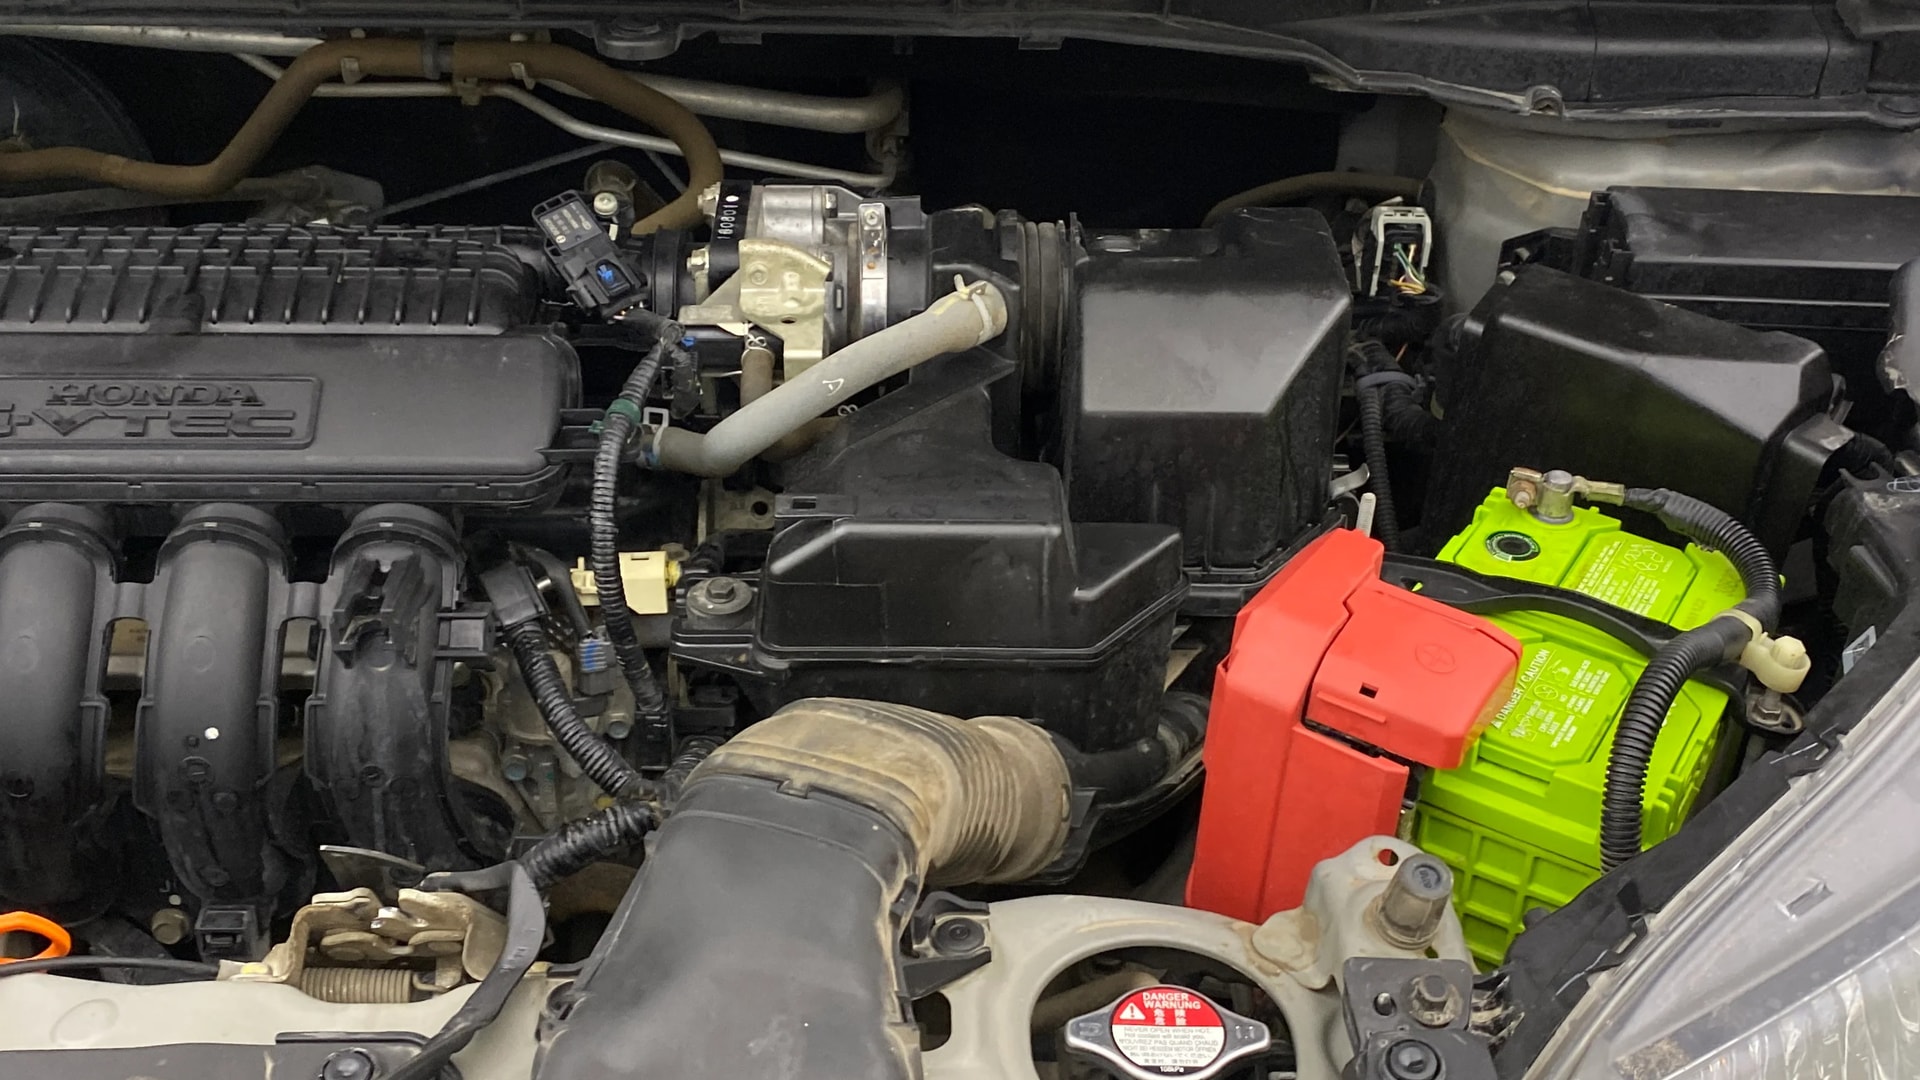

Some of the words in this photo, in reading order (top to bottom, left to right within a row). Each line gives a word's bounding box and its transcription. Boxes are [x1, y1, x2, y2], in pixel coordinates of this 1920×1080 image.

[45, 383, 265, 408] HONDA
[1496, 687, 1526, 721] DANGER
[1520, 648, 1551, 682] CAUTION
[1142, 992, 1189, 1001] DANGER
[1143, 1000, 1202, 1010] WARNUNG
